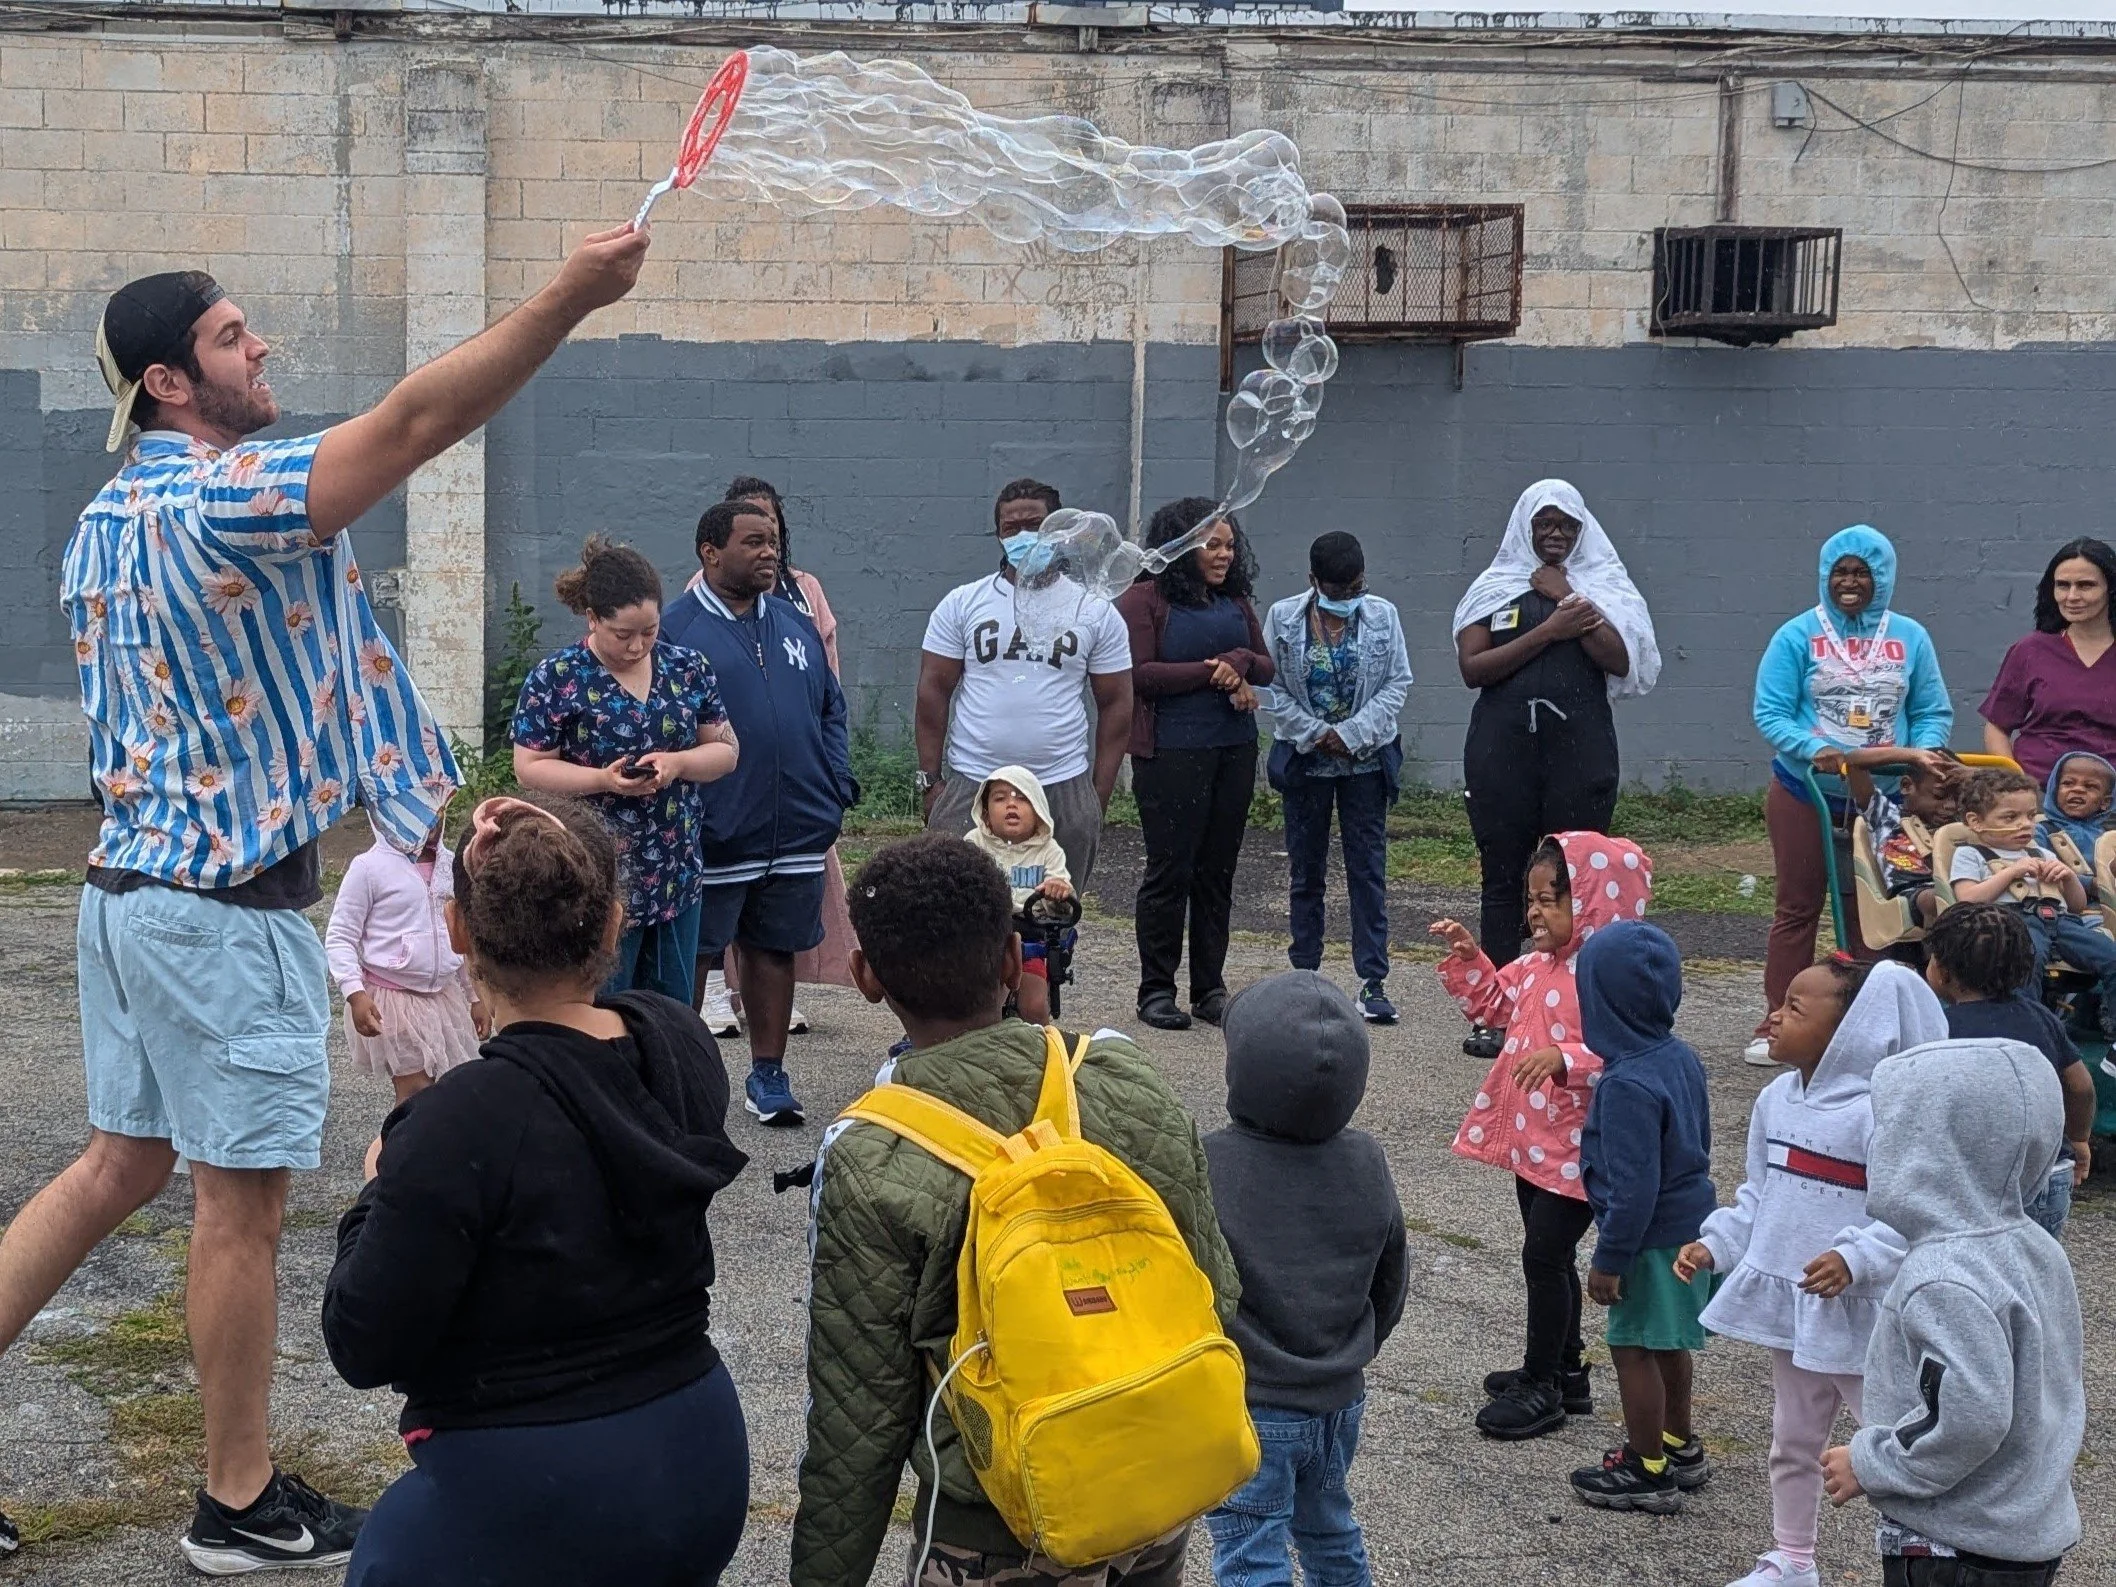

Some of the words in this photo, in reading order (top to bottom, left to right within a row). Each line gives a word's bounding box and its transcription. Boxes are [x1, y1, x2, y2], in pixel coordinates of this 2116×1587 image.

[782, 636, 809, 671] NY
[974, 619, 1079, 670] GAP
[1768, 1129, 1831, 1152] OMMY
